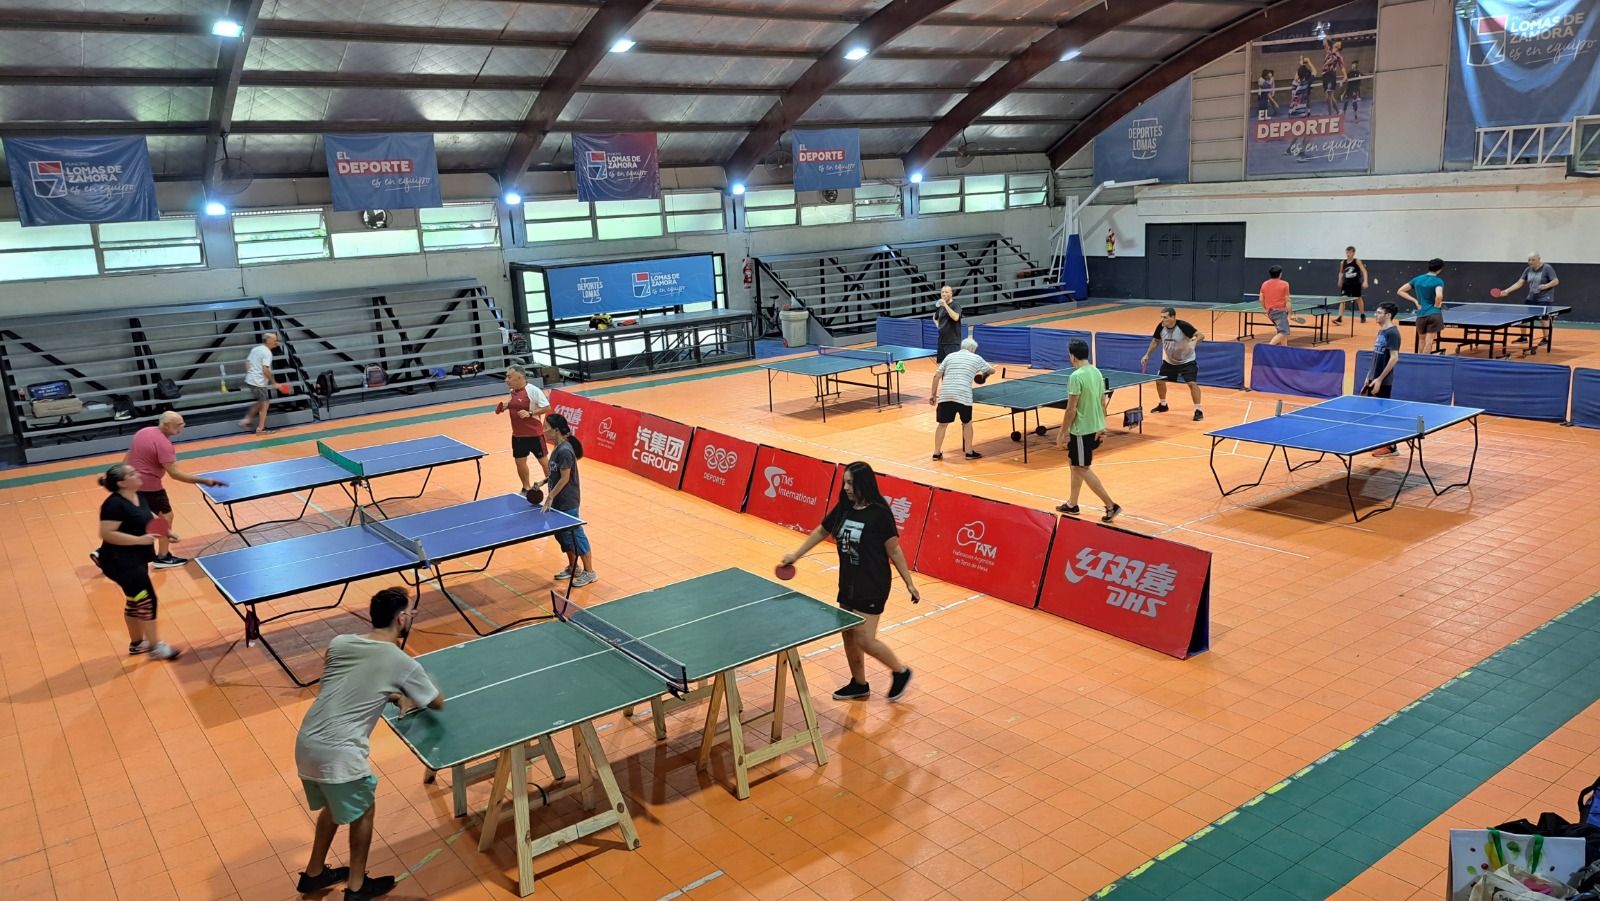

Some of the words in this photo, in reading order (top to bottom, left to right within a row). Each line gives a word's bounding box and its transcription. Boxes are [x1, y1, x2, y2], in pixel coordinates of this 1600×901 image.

[1511, 16, 1560, 32] LOMAS
[1563, 12, 1585, 26] DE
[1510, 26, 1574, 44] ZAMORA
[1510, 48, 1521, 60] es
[1526, 47, 1542, 56] en
[1547, 39, 1597, 64] equipo
[1258, 110, 1271, 120] EL
[1129, 126, 1162, 138] DEPORTES
[1257, 117, 1340, 138] DEPORTE
[1133, 138, 1156, 151] LOMAS
[1290, 143, 1302, 155] es
[1306, 143, 1318, 152] en
[1322, 138, 1365, 162] equipo
[336, 152, 350, 160] EL
[800, 151, 843, 161] DEPORTE
[66, 166, 106, 175] LOMAS
[338, 161, 410, 174] DEPORTE
[68, 174, 118, 183] ZAMORA
[372, 178, 381, 188] es
[398, 177, 432, 192] equipo
[70, 186, 80, 195] es
[100, 184, 136, 199] equipo
[577, 282, 603, 290] DEPORTES
[582, 290, 600, 298] LOMAS
[641, 451, 678, 473] GROUP
[703, 472, 726, 486] DEPORTE
[781, 475, 794, 486] TMS
[778, 486, 817, 506] International
[1065, 547, 1178, 597] 红双喜
[1106, 586, 1167, 617] DHS
